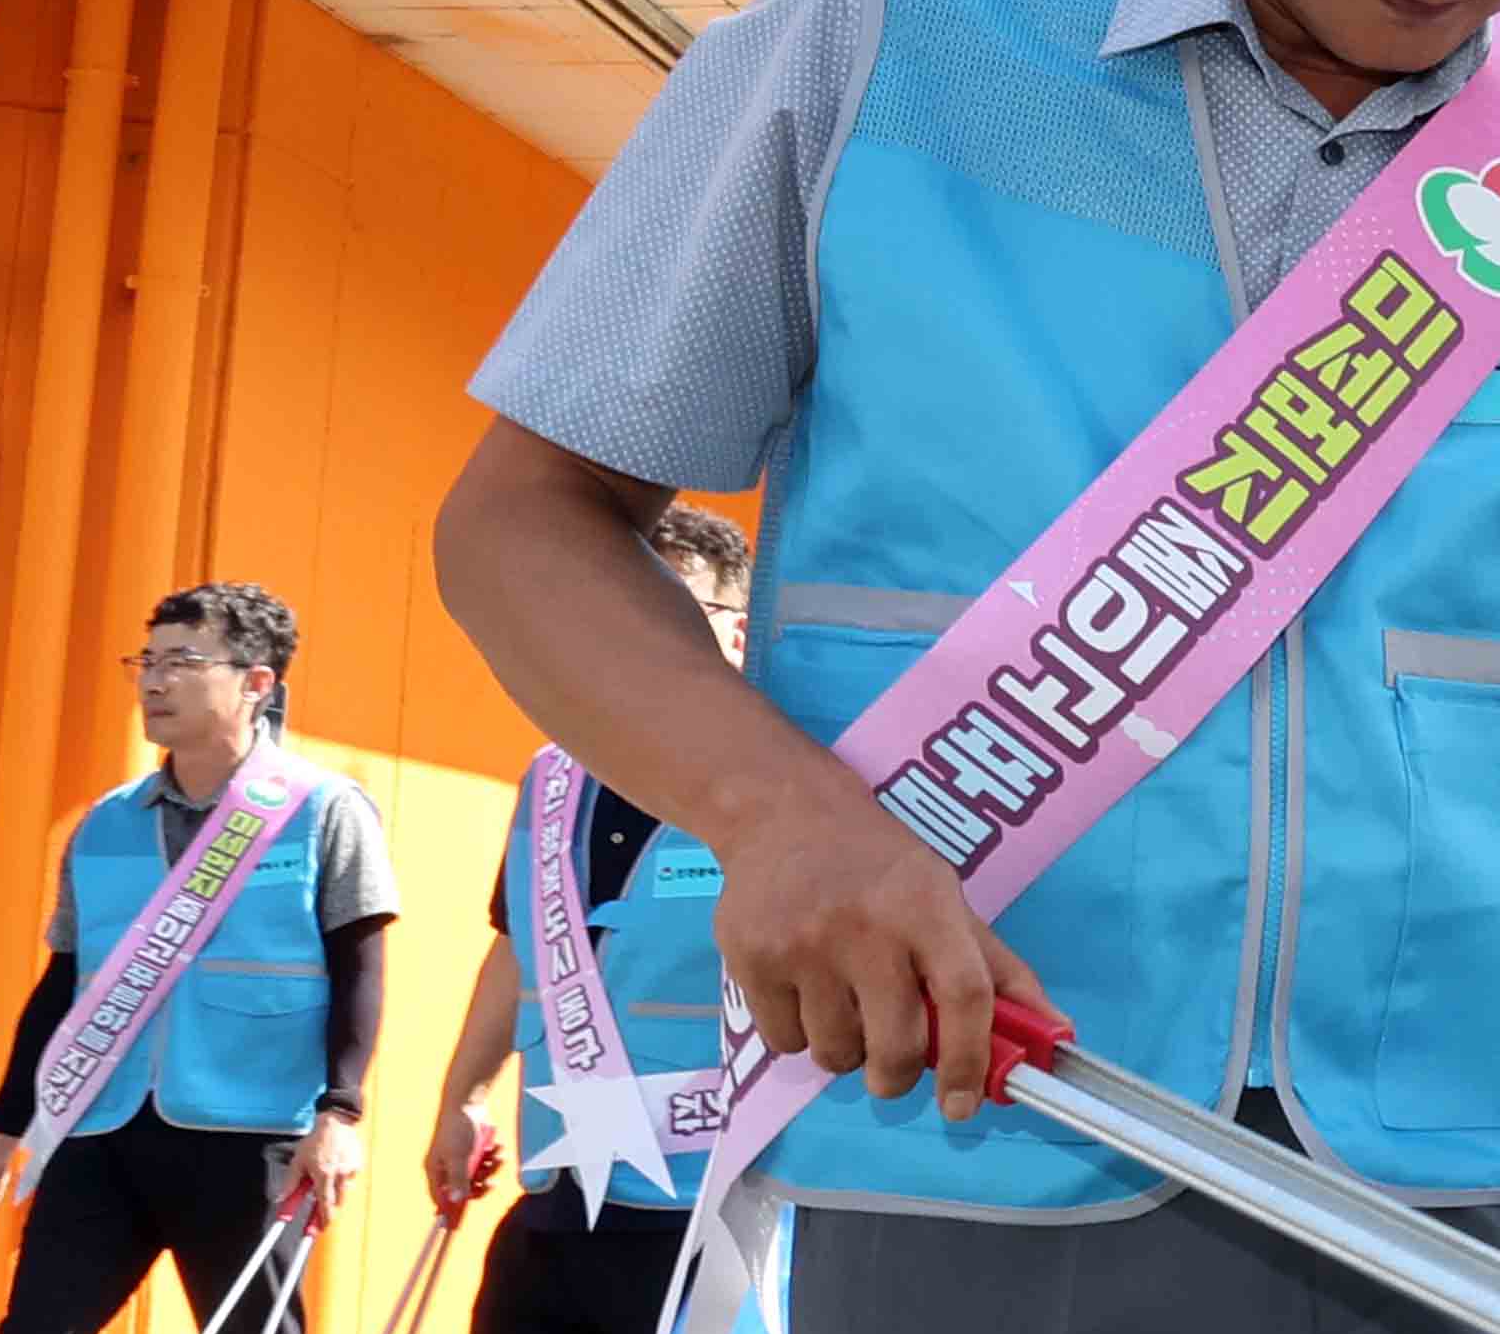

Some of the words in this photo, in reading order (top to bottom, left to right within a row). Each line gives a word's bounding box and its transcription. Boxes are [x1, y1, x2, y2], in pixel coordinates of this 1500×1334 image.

[1180, 251, 1463, 551] 미세먼지
[992, 499, 1250, 753] 줄이고
[182, 808, 266, 901] 미세먼지
[137, 893, 207, 969] 줄이고
[554, 983, 606, 1072] 동구
